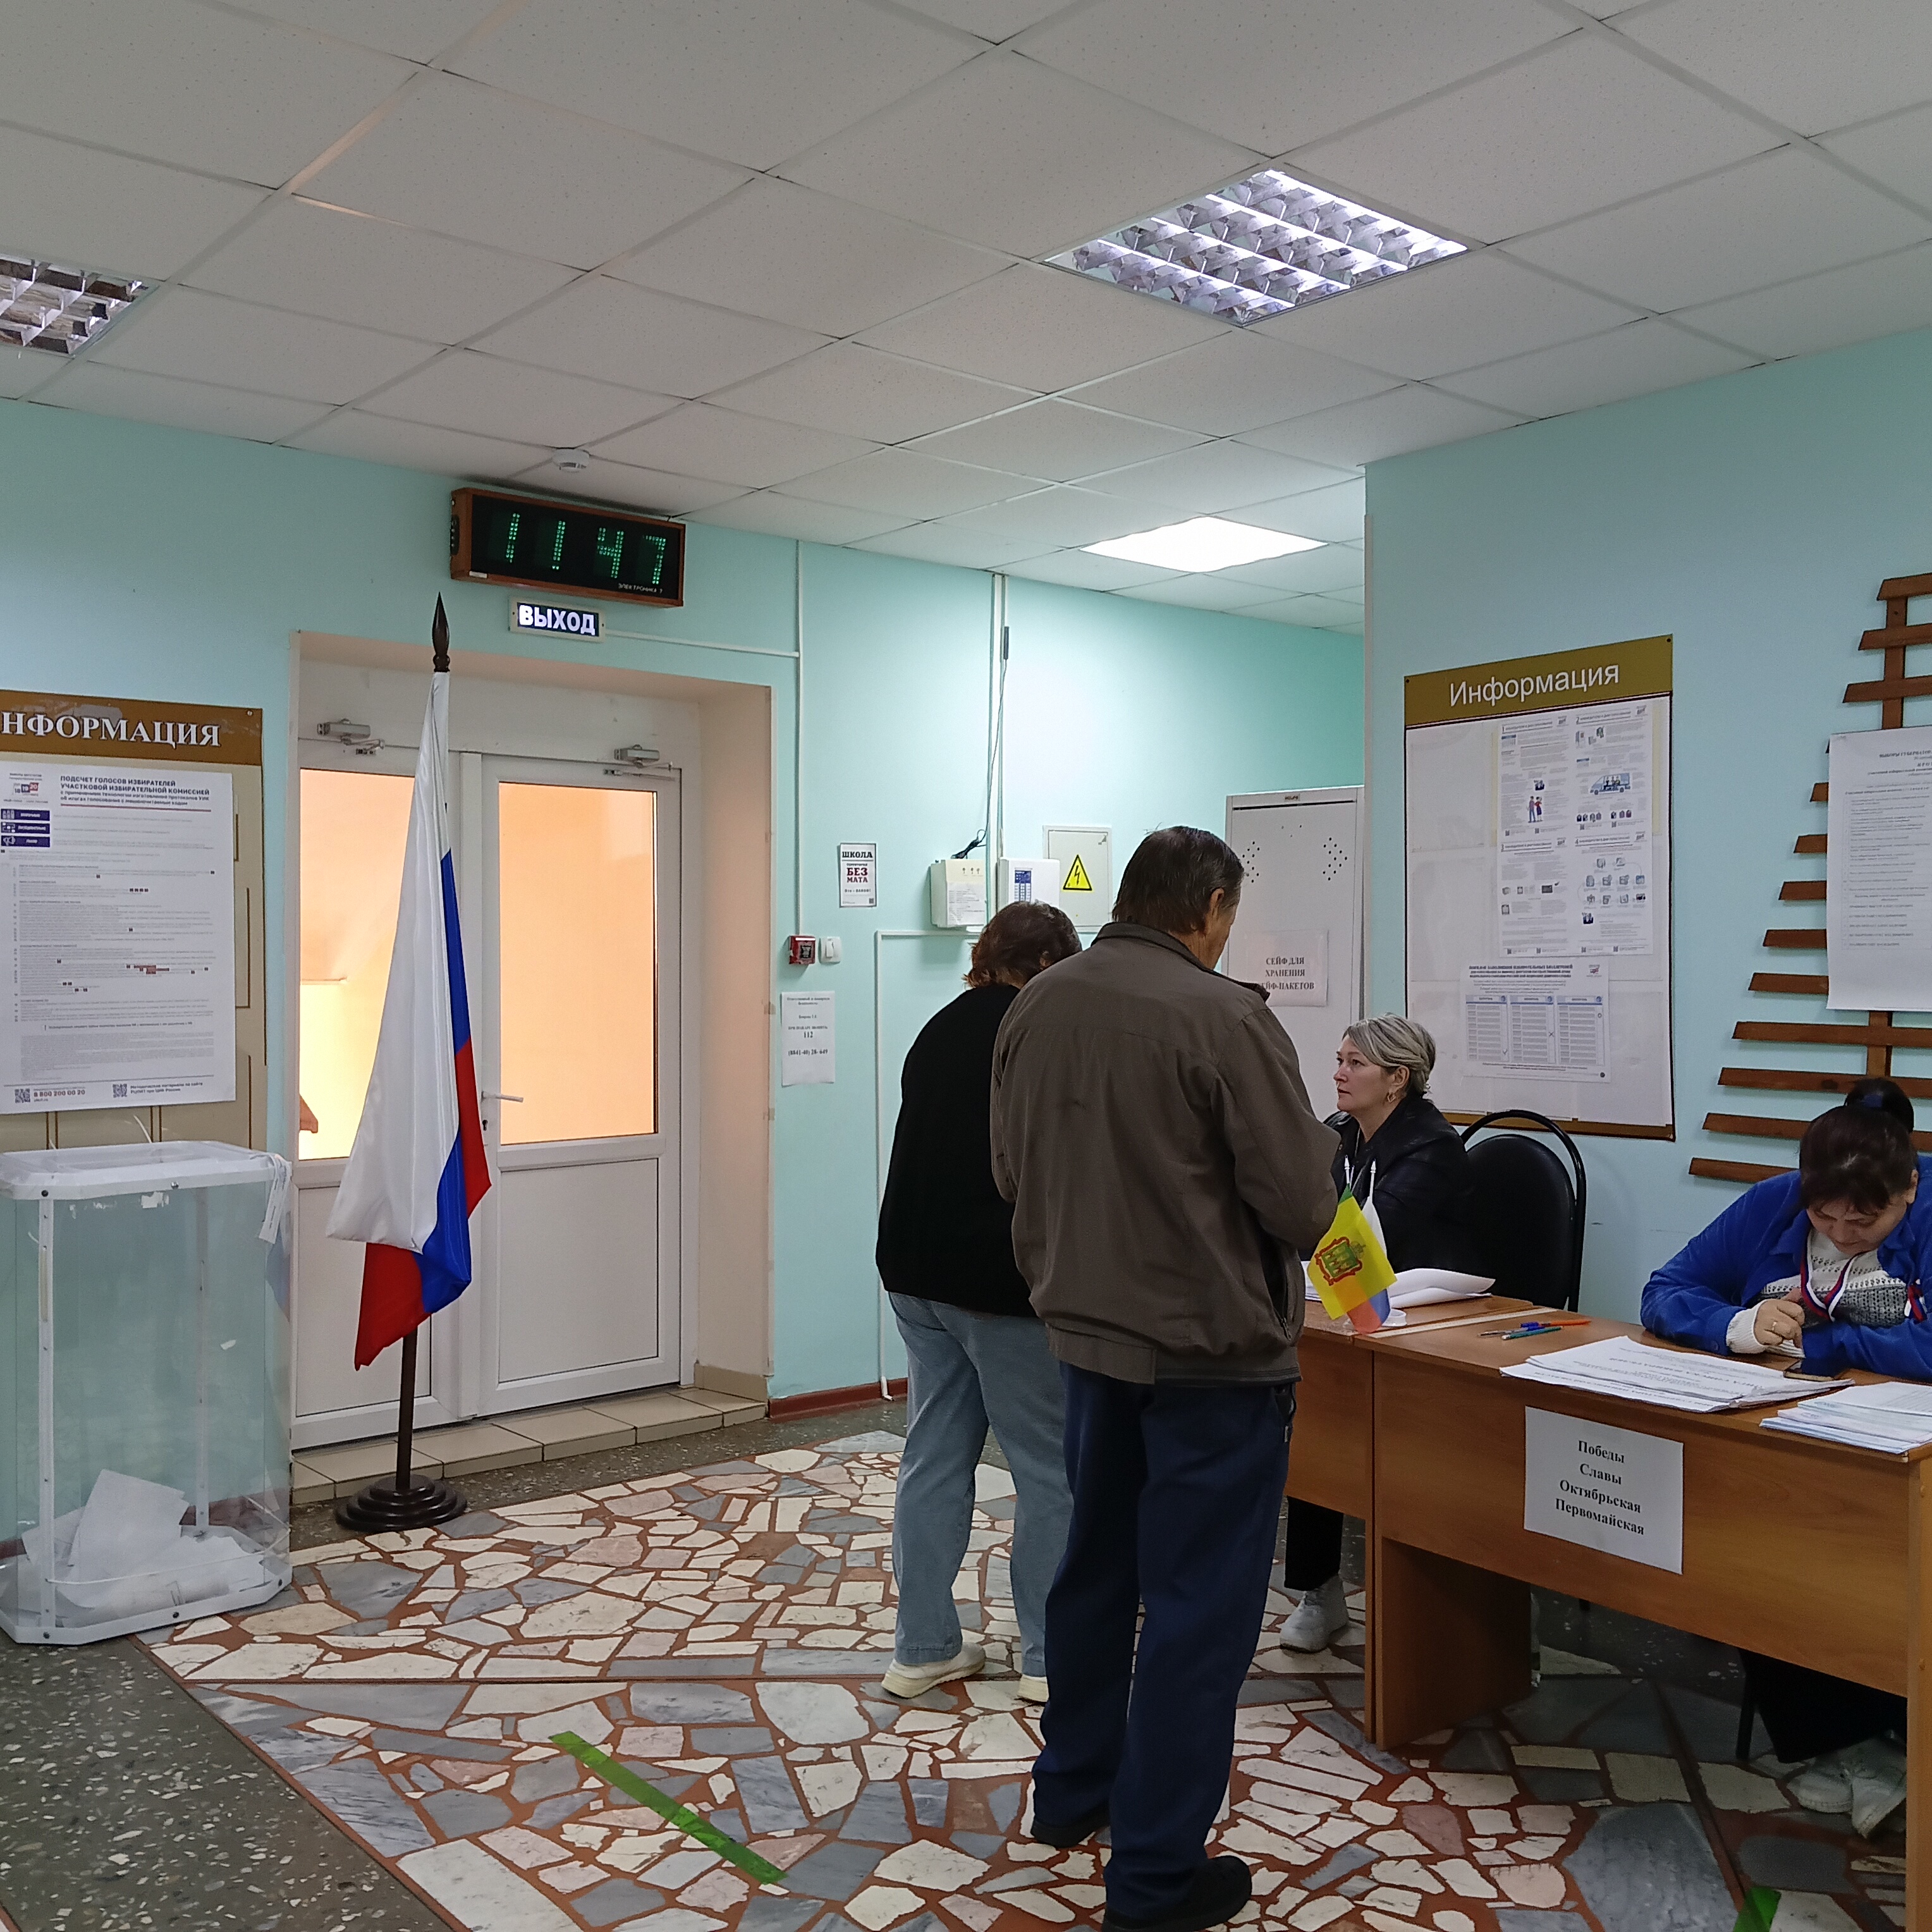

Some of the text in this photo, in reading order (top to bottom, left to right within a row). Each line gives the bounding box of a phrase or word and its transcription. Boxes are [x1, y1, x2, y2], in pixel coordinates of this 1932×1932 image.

[518, 604, 596, 635] ВЫХОД
[1448, 664, 1620, 707] Информация
[109, 785, 167, 793] ИЗБИРАТЕЛЬНОЙ
[847, 867, 868, 876] БЕЗ
[1266, 955, 1305, 966] СЕЙФ ДЛЯ
[1265, 969, 1305, 977] ХРАНЕНИЯ
[1261, 981, 1314, 990] ЕЙФ-ПАКЕТОВ
[1578, 1440, 1625, 1464] Победы
[1579, 1463, 1622, 1485] Славы
[1559, 1479, 1641, 1513] Октябрьская
[1555, 1498, 1645, 1536] Первомайская
